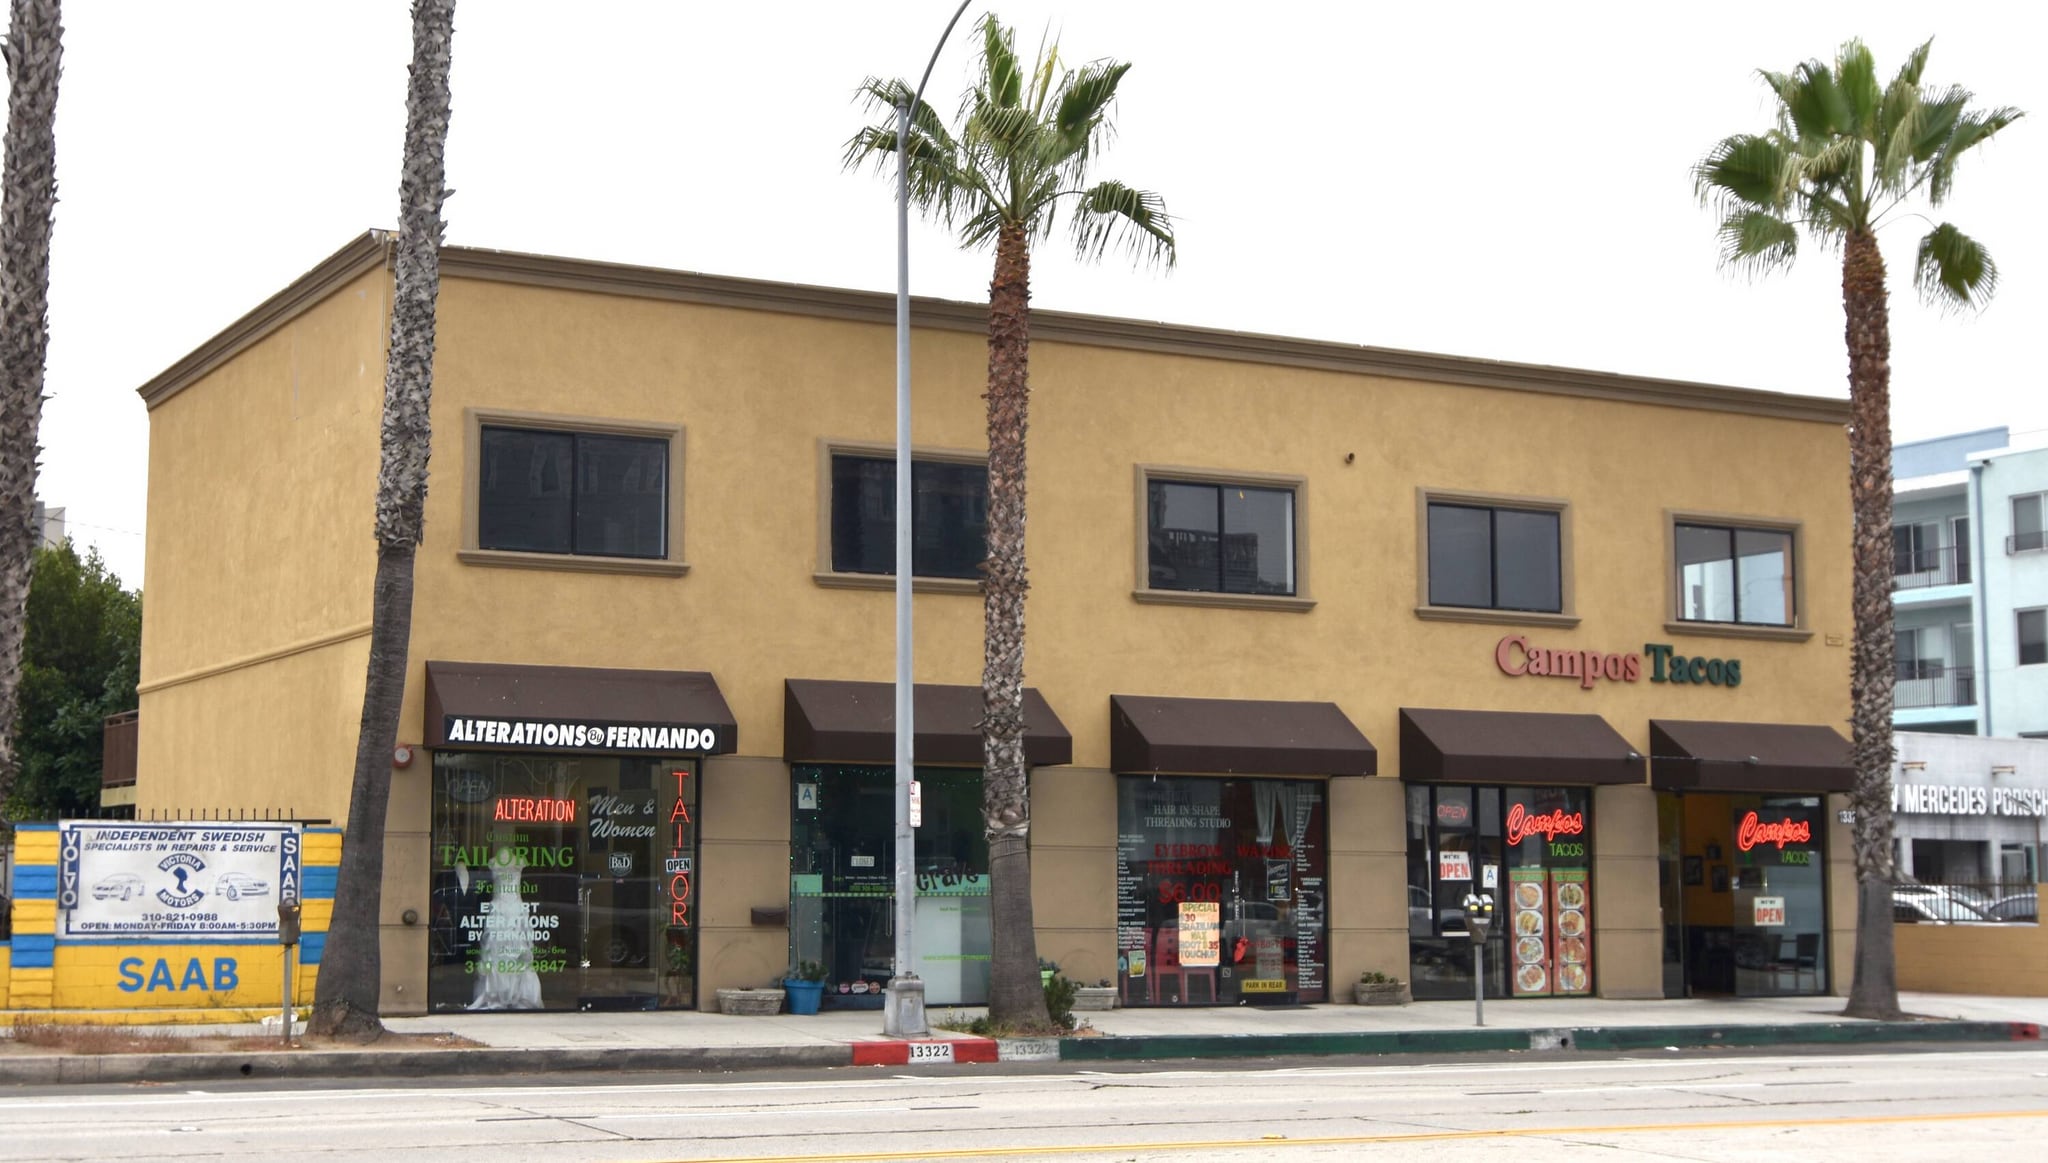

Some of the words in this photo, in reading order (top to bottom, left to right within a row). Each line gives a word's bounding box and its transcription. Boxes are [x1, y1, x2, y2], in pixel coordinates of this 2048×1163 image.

[1495, 634, 1642, 690] Campos
[1645, 643, 1742, 688] Tacos
[449, 718, 587, 747] ALTERATIONS
[606, 726, 716, 750] FERNANDO
[802, 787, 812, 801] A
[1905, 783, 1987, 815] MERCEDES
[494, 798, 575, 822] ALTERATION
[590, 794, 636, 815] Men
[1153, 804, 1177, 816] HAIR
[1180, 805, 1190, 816] IN
[1192, 805, 1221, 816] SHAPE
[1437, 804, 1468, 820] OPEN
[589, 818, 657, 838] Women
[1144, 816, 1197, 828] THREADING
[1200, 817, 1231, 829] STUDIO
[1506, 803, 1584, 846] Campos
[96, 830, 196, 842] INDEPENDENT
[201, 831, 266, 842] SWEDISH
[1738, 811, 1811, 852] Campos
[84, 843, 153, 852] SPECIALISTS
[156, 843, 168, 852] IN
[171, 843, 217, 852] REPAIRS
[220, 844, 227, 852] &
[232, 844, 278, 853] SERVICE
[1154, 843, 1223, 858] EYEBROW
[1550, 842, 1584, 857] TACOS
[160, 854, 203, 871] VICTORIA
[439, 845, 575, 868] TAILORING
[1782, 850, 1810, 864] TACOS
[61, 832, 79, 906] VOLVO
[667, 859, 690, 871] OPEN
[1440, 863, 1469, 878] OPEN
[1486, 869, 1494, 881] A
[160, 890, 200, 907] MOTORS
[480, 902, 540, 913] EXRT
[1182, 903, 1218, 912] SPECIAL
[142, 913, 219, 921] 310-821-0988
[460, 915, 560, 929] ALTERATIONS
[1757, 908, 1783, 923] OPEN
[468, 930, 483, 941] BY
[490, 930, 551, 941] FERNANDO
[531, 959, 567, 974] 9847
[117, 957, 239, 992] SAAB
[1245, 981, 1260, 989] PARK
[1262, 981, 1268, 989] IN
[1269, 981, 1283, 989] REAR
[910, 1045, 950, 1058] 13322
[1015, 1042, 1050, 1056] 13322
